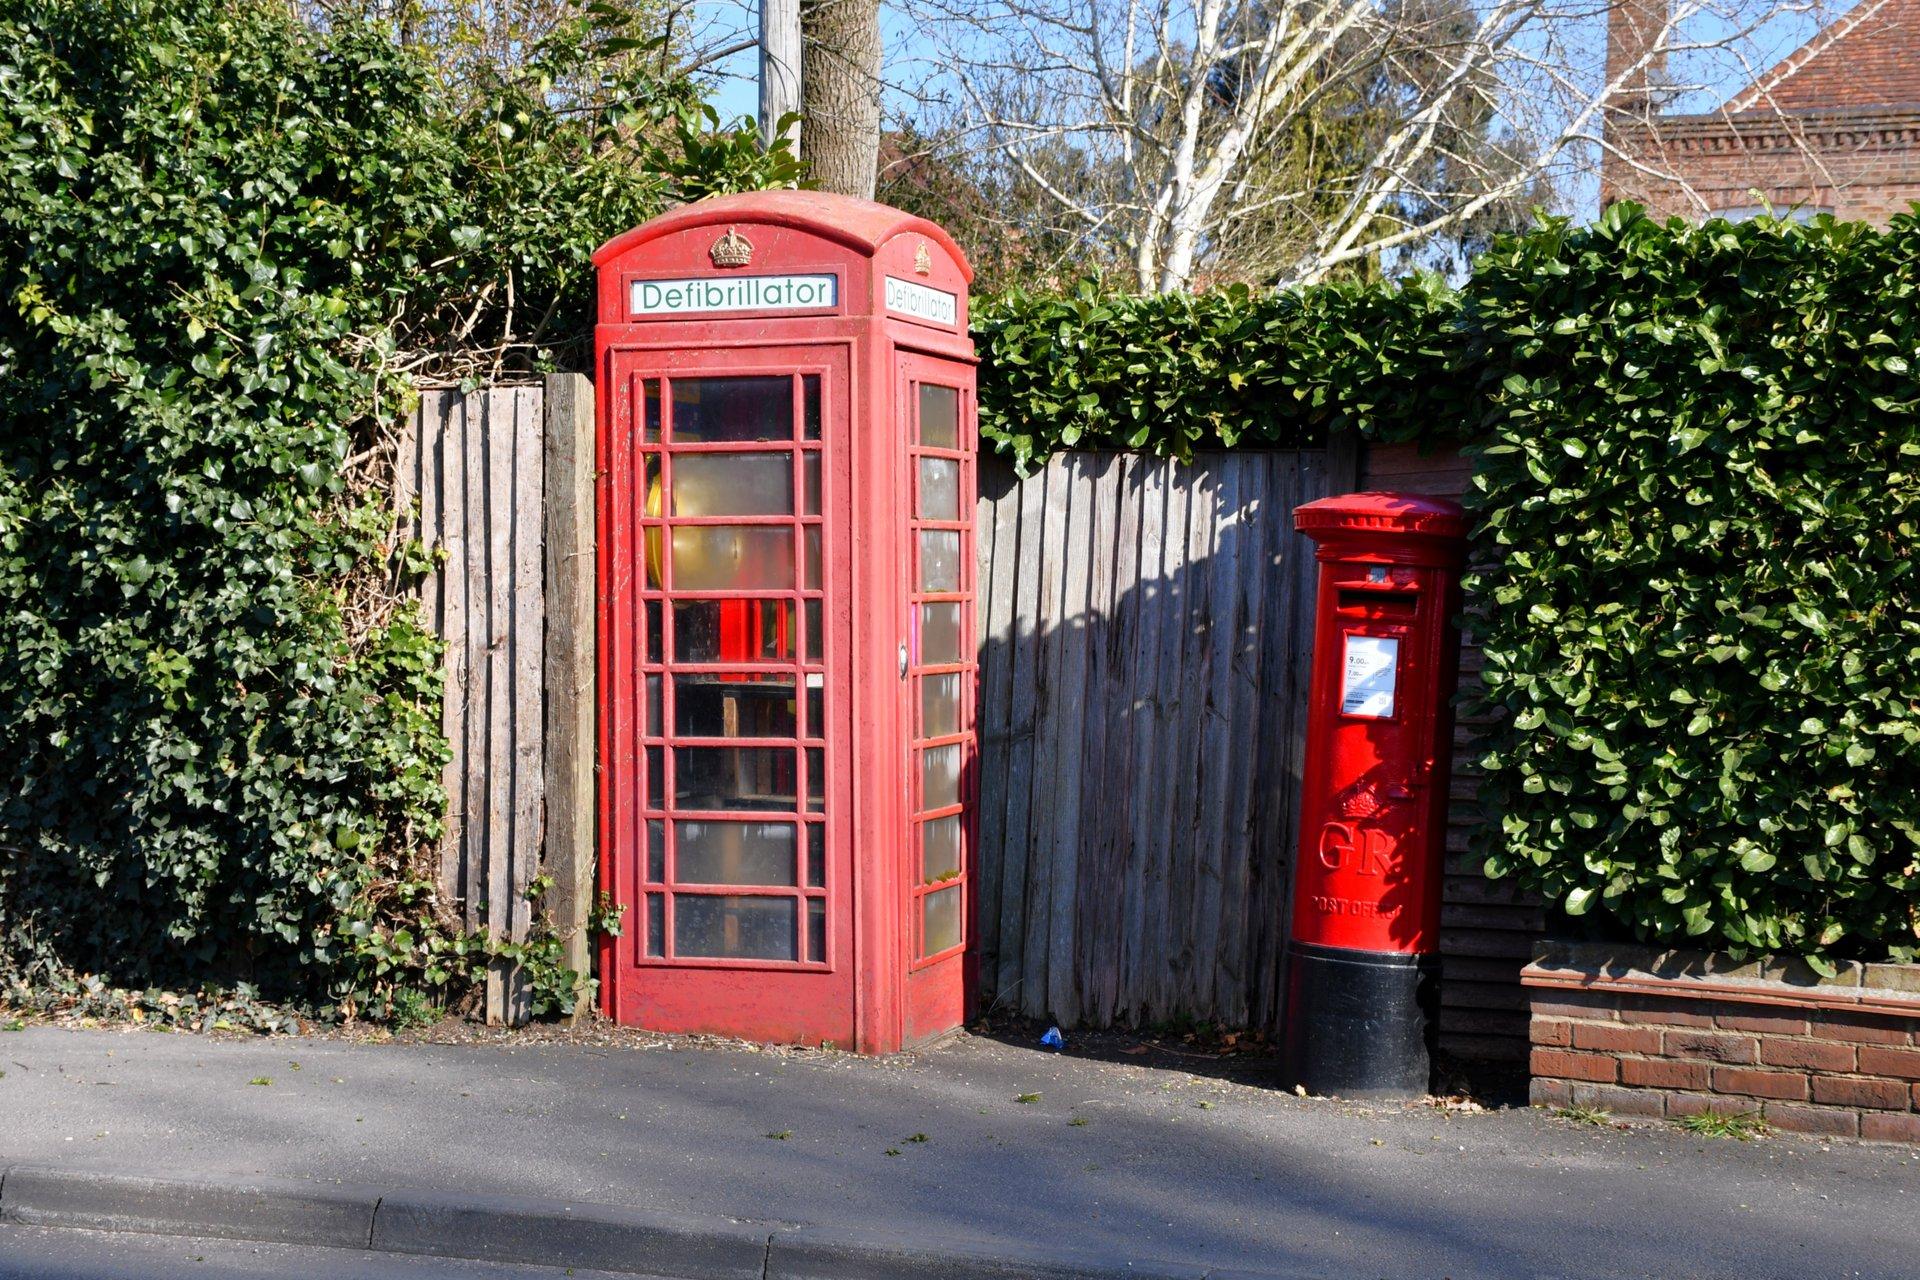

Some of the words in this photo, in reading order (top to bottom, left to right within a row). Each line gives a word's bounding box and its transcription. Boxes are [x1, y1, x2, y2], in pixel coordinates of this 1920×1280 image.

[643, 278, 826, 309] Defibrillator
[887, 280, 952, 321] Defibrillator
[1319, 821, 1399, 877] GR
